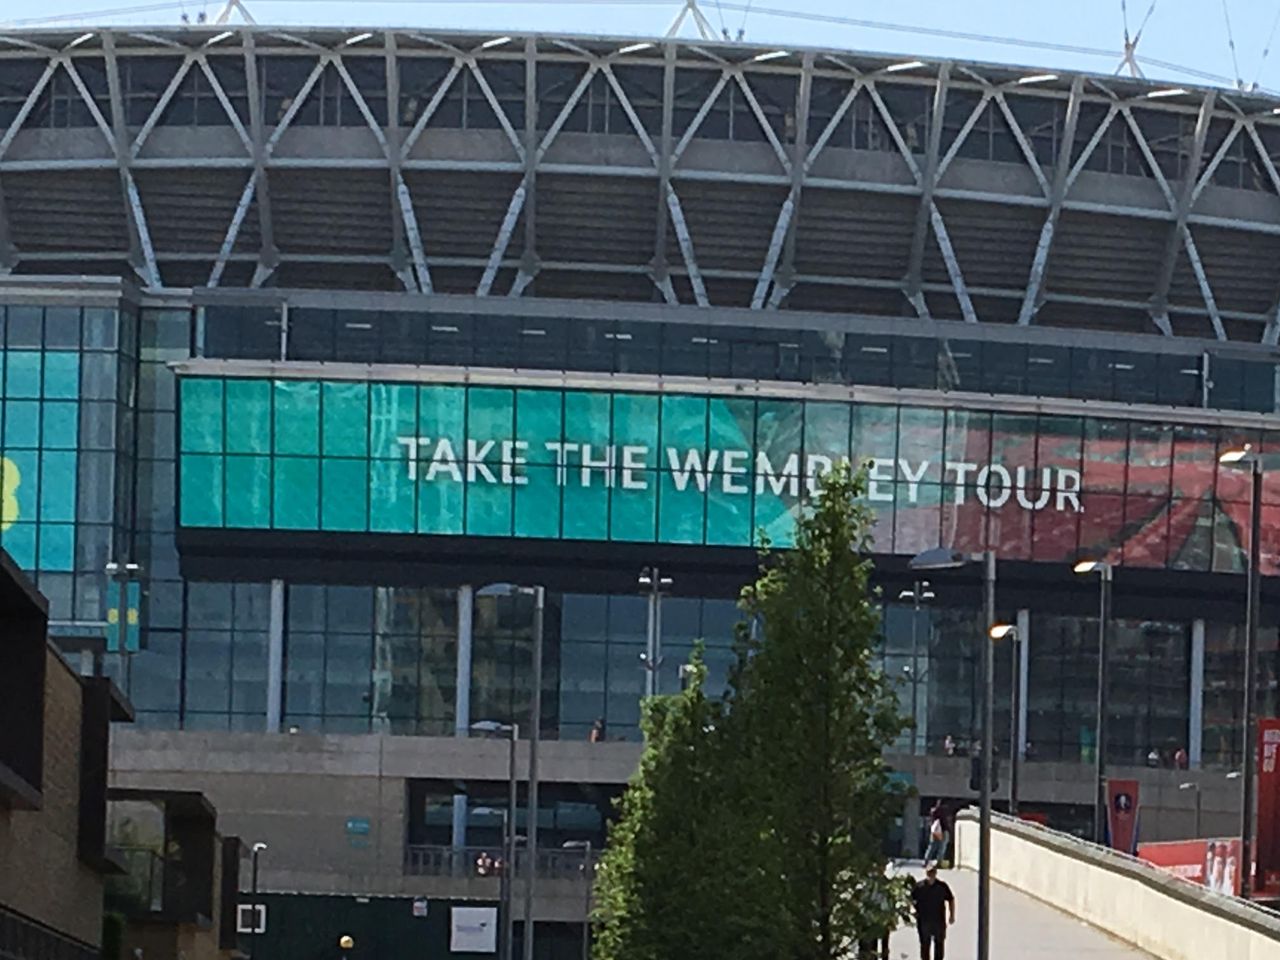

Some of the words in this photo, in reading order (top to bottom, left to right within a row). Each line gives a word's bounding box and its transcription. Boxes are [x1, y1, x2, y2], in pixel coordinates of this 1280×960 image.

[397, 437, 529, 485] TAKE
[545, 442, 649, 490] THE
[666, 446, 929, 503] WEMBEY
[945, 461, 1085, 513] TOUR
